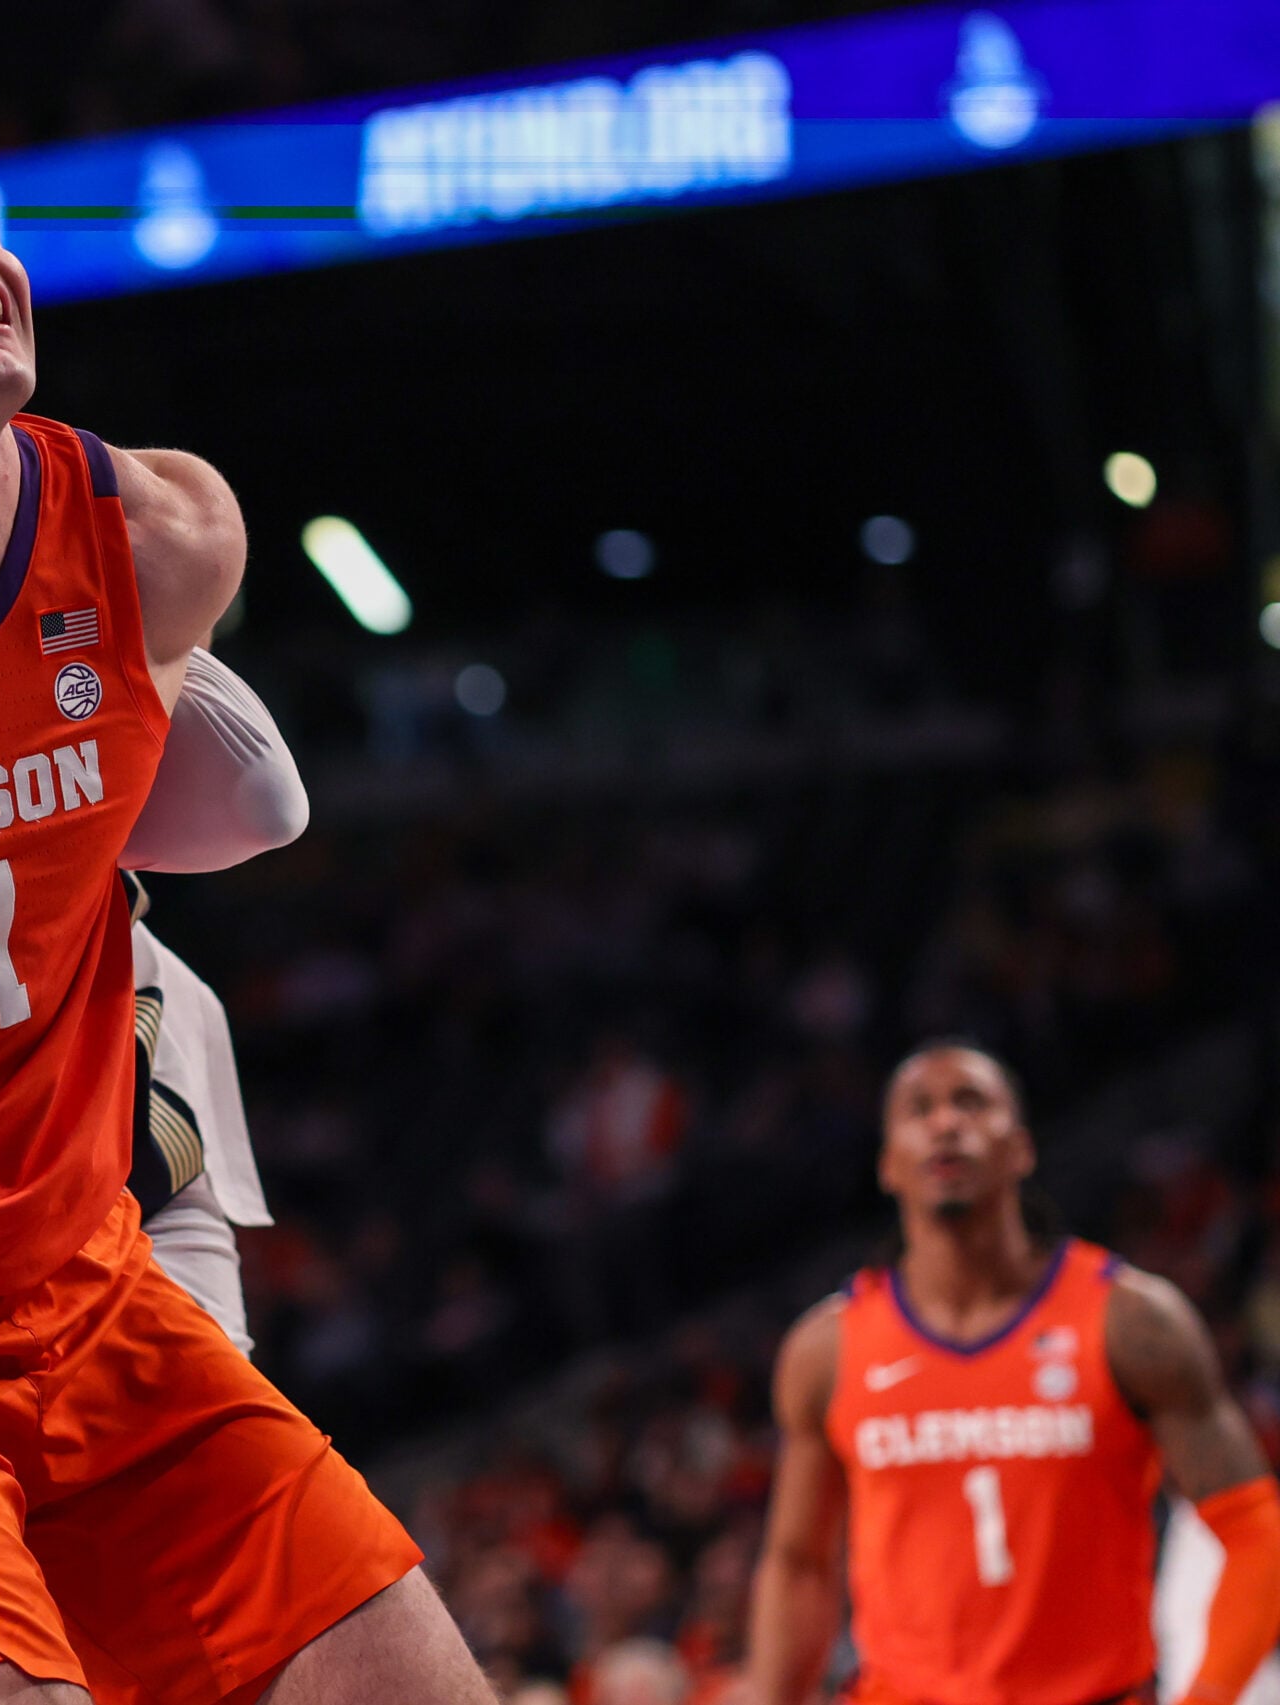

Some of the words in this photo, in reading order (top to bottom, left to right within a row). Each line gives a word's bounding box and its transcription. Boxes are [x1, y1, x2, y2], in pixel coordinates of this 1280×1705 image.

[63, 679, 96, 697] ACC
[855, 1403, 1092, 1469] CLEMSON
[963, 1465, 1014, 1586] 1
